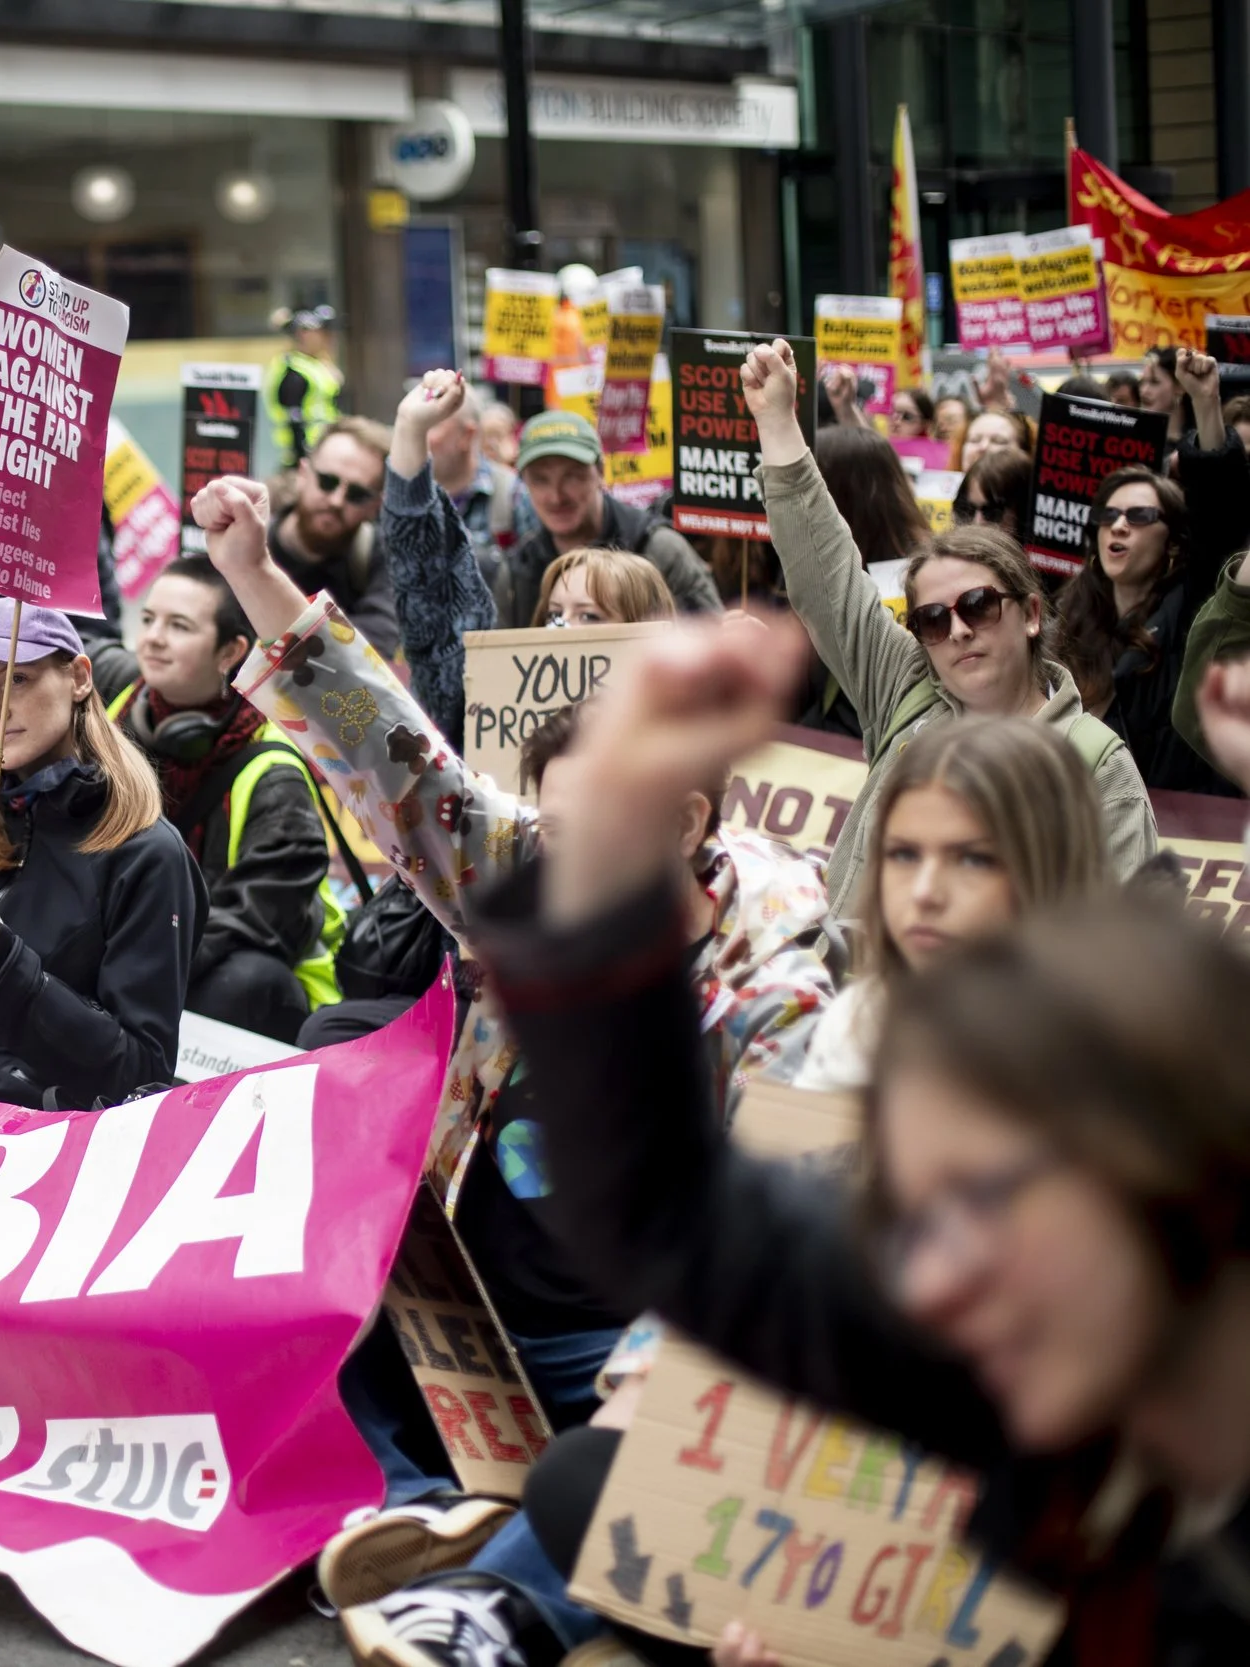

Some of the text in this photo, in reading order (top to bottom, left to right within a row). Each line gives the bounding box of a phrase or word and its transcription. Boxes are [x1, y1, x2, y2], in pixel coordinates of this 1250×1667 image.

[72, 299, 90, 316] UP
[679, 363, 742, 387] SCOT
[680, 389, 726, 414] USE
[42, 410, 82, 463] FAR
[1044, 423, 1099, 451] SCOT
[679, 446, 750, 476] MAKE
[1042, 446, 1083, 473] USE
[680, 471, 737, 499] RICH
[22, 516, 42, 542] lies
[1033, 515, 1083, 547] RICH
[35, 555, 56, 576] are
[13, 567, 52, 599] blame
[512, 654, 611, 704] YOUR
[720, 775, 854, 848] NOT
[677, 1380, 734, 1474] 1
[693, 1496, 844, 1610] 17YO
[851, 1542, 993, 1650] GIRL
